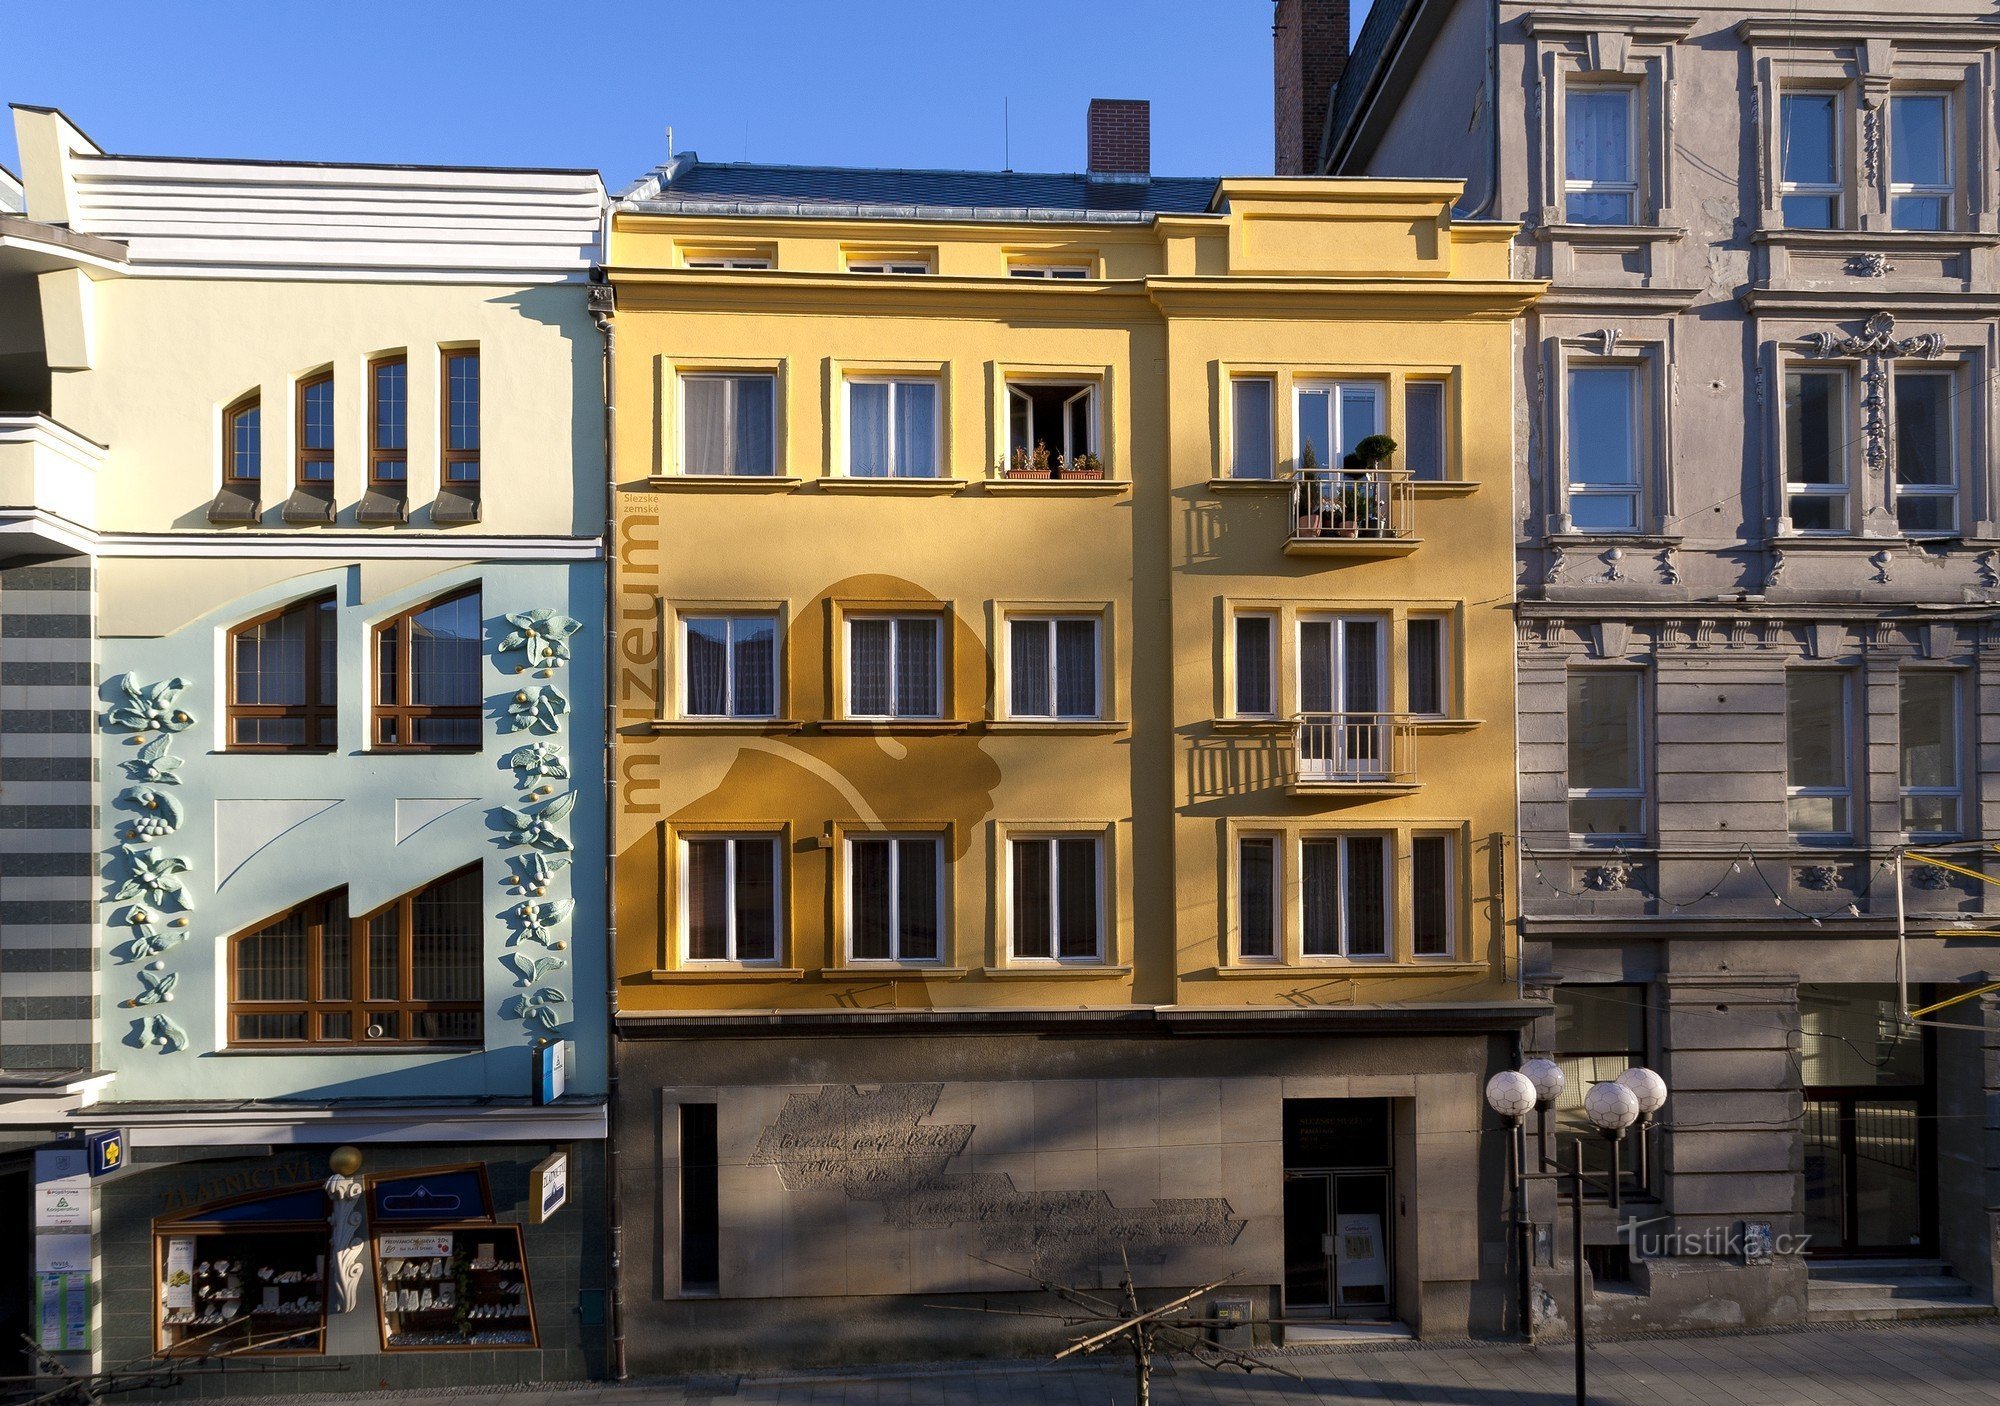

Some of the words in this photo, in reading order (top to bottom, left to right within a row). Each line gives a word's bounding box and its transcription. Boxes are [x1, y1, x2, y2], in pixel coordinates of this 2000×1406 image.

[623, 504, 659, 513] zemské
[624, 493, 659, 503] Slezské
[621, 515, 661, 814] muzeum
[160, 1158, 312, 1208] ZLATNICTVÍ
